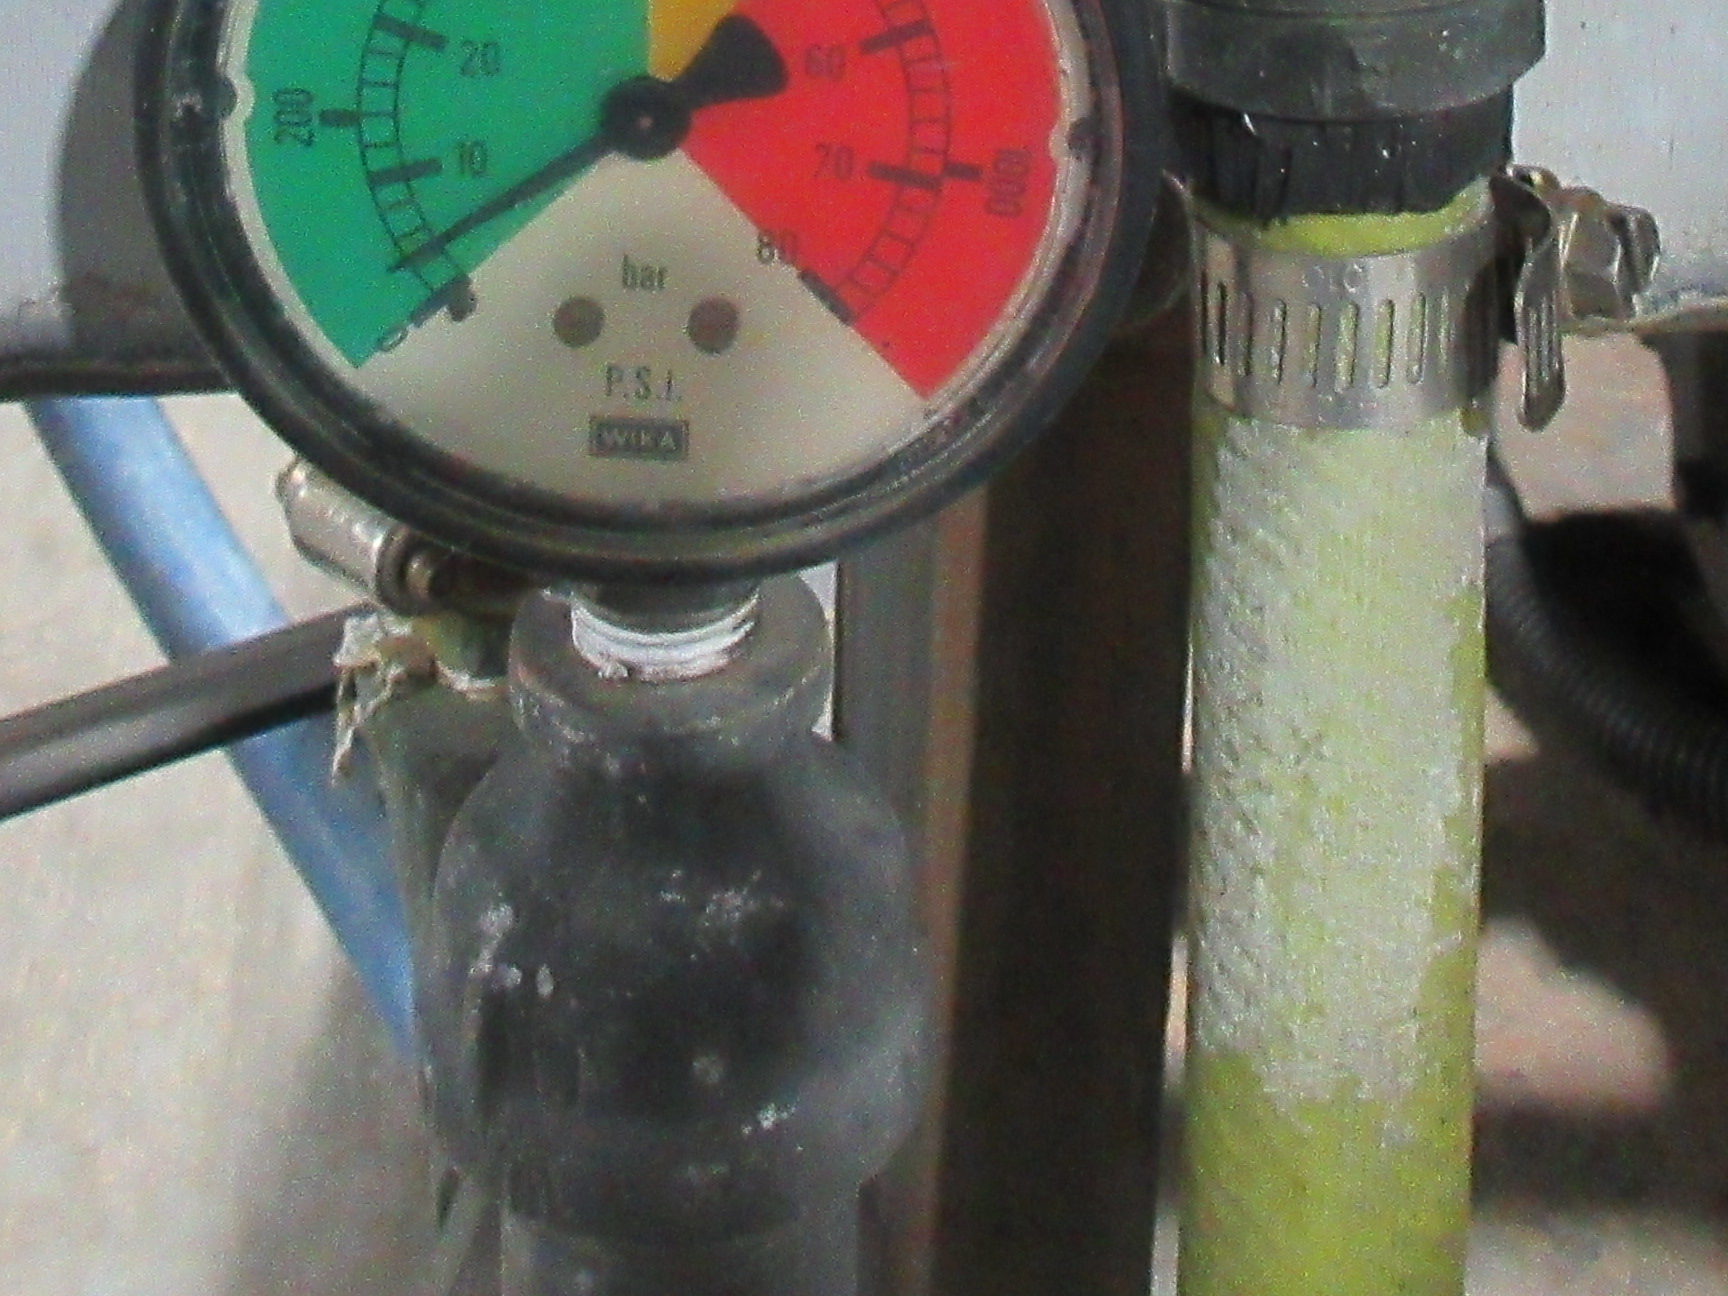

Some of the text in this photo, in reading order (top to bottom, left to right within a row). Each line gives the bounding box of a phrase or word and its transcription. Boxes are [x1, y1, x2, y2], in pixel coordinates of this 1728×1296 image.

[459, 39, 502, 78] 20
[803, 43, 846, 82] 60
[272, 86, 315, 147] 200
[459, 139, 490, 177] 10
[815, 141, 854, 181] 70
[756, 228, 800, 266] 80
[621, 253, 669, 291] bar
